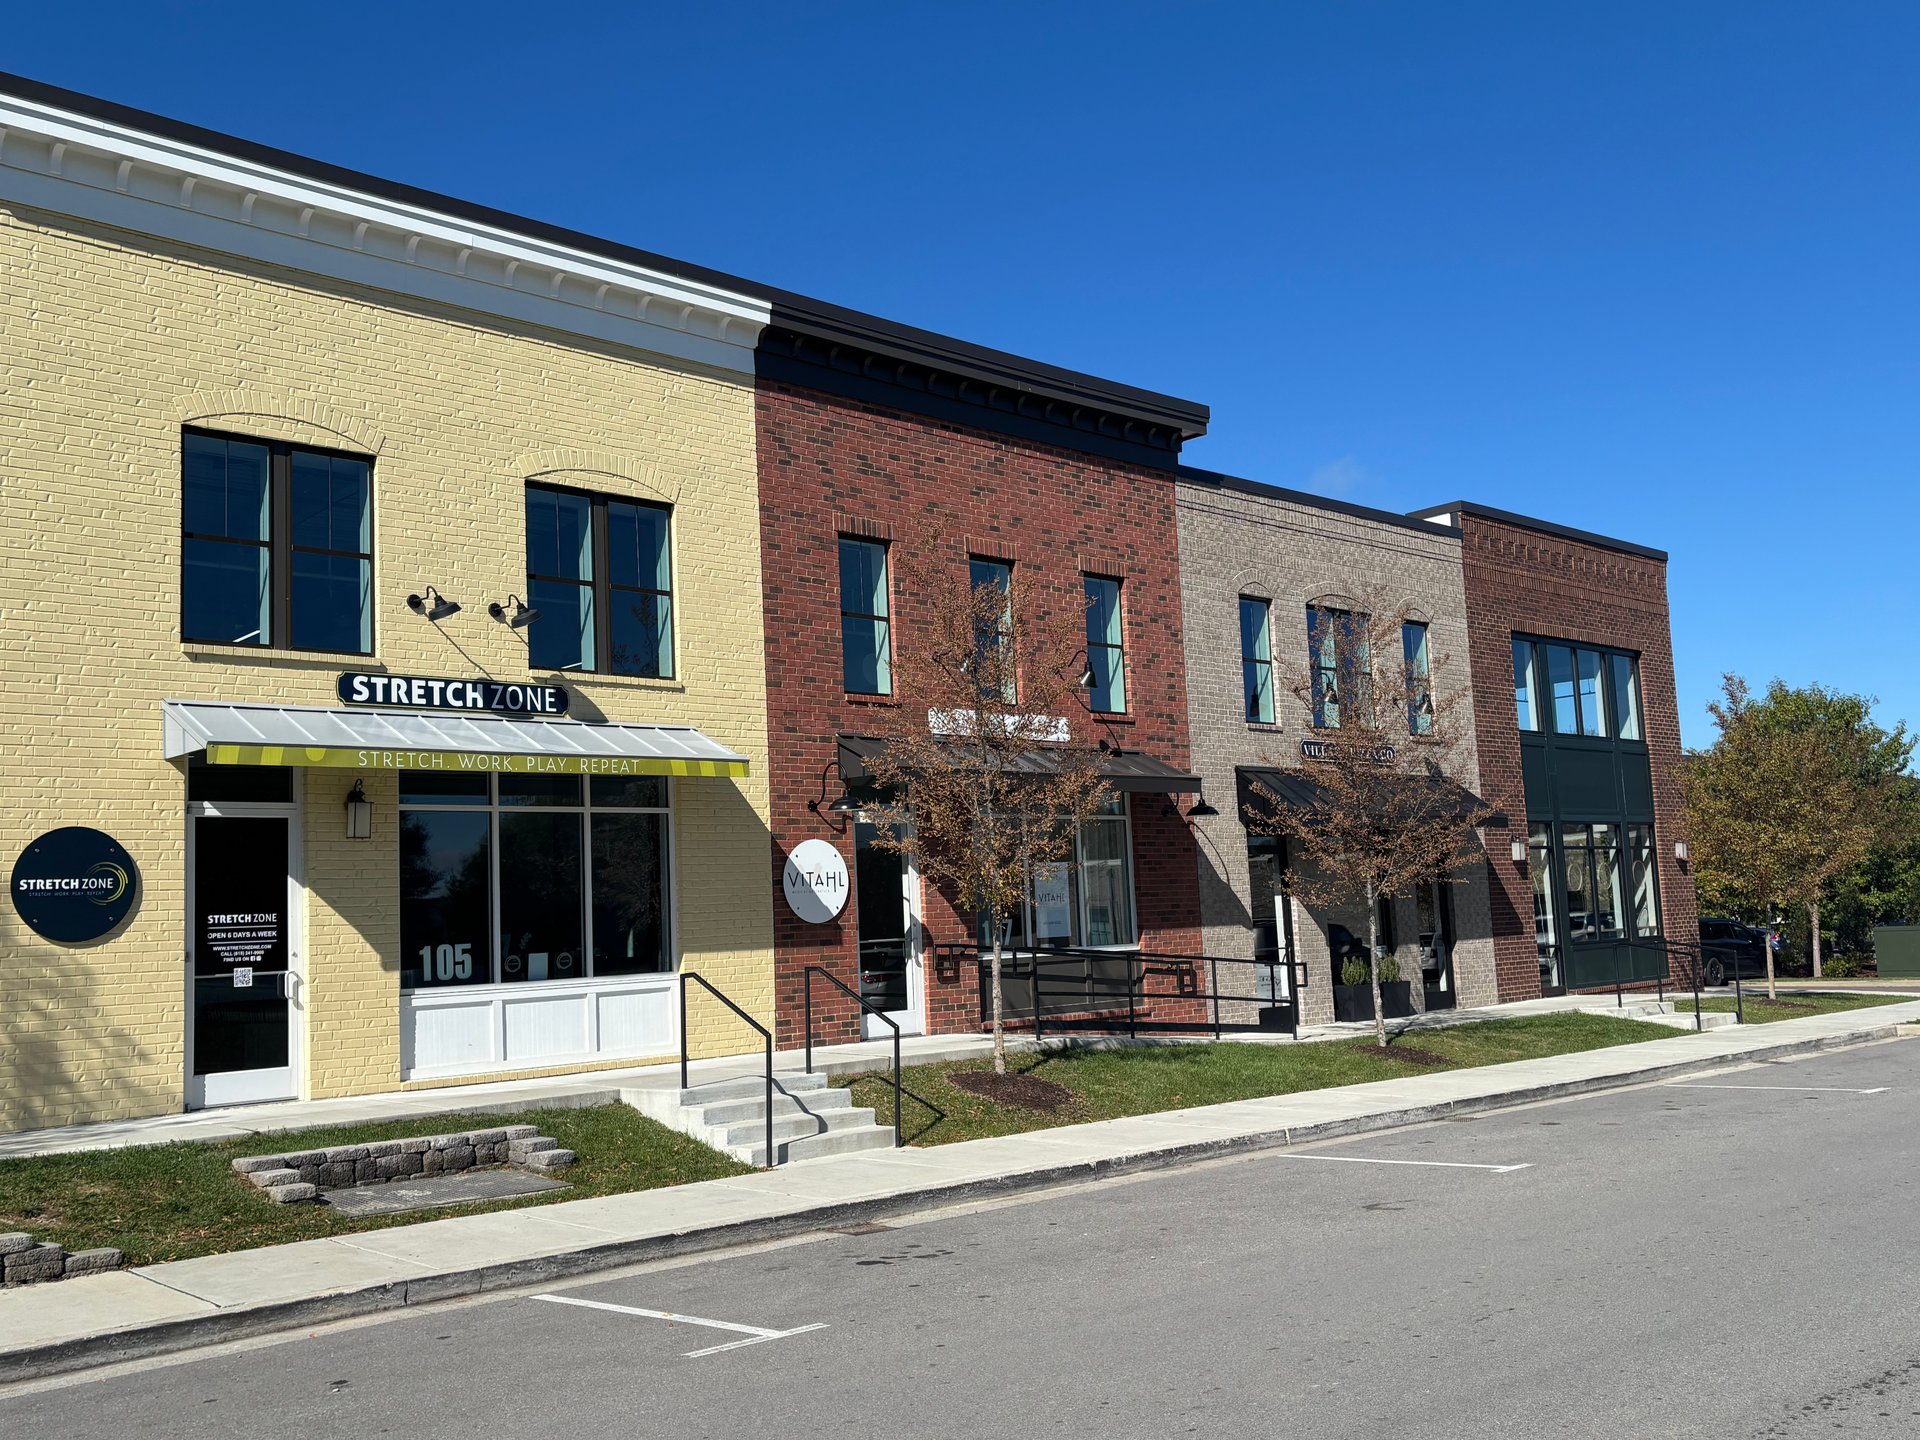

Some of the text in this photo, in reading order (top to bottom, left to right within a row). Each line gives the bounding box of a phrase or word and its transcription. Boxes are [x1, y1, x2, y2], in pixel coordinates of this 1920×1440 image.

[352, 676, 557, 712] STRETCH ZONE
[358, 751, 644, 774] STRETCH. WORK. PLAY. REPEAT.
[19, 877, 114, 890] STRETCH ZONE
[787, 871, 845, 893] VITAHL
[207, 913, 277, 924] STRETCH ZONE
[982, 918, 1013, 947] 17
[419, 943, 472, 982] 105
